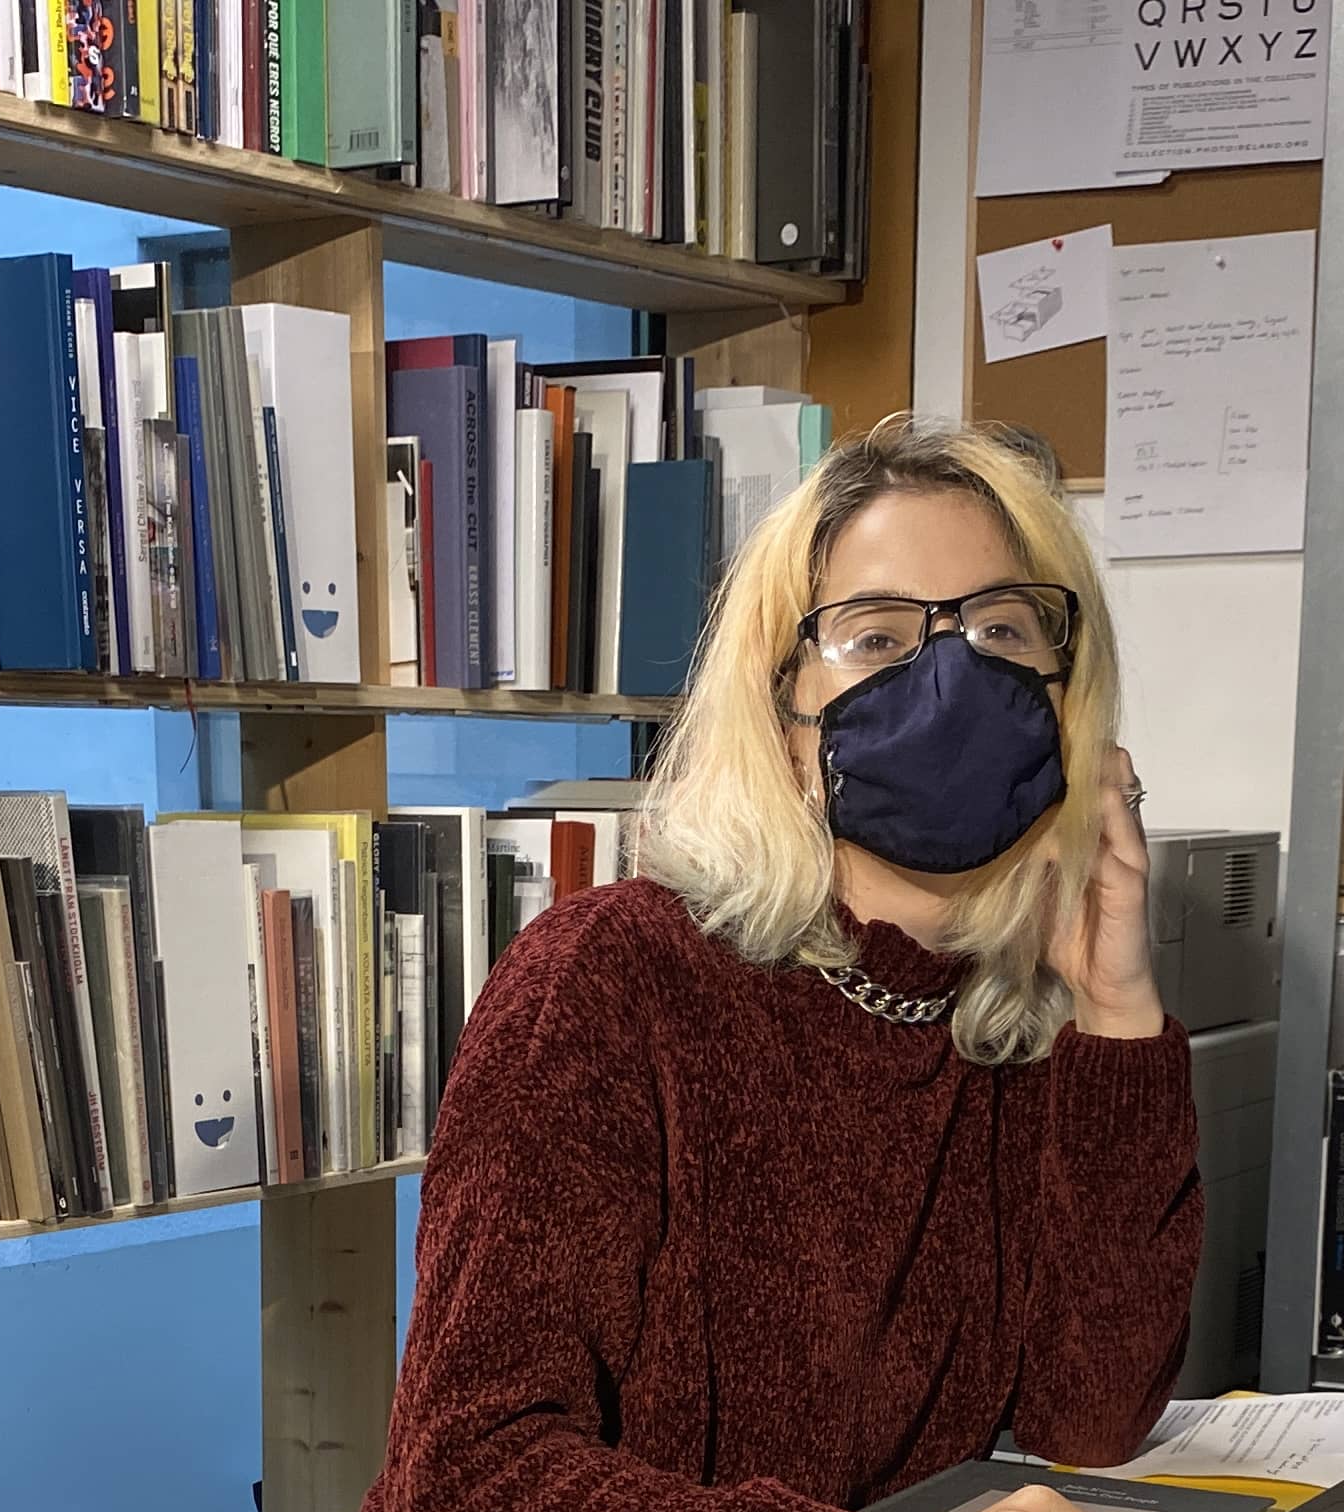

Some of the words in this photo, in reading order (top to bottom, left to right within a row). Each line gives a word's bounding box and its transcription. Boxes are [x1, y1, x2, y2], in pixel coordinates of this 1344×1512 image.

[267, 1, 280, 28] POR
[268, 62, 281, 96] ERES
[268, 99, 281, 153] NEGRO?
[585, 89, 604, 163] CLUB
[68, 375, 81, 453] VICE
[466, 390, 477, 468] ACROSS
[466, 477, 477, 505] the
[74, 478, 88, 575] VERSA
[466, 513, 477, 552] CUT
[81, 589, 91, 636] contrasto
[468, 611, 479, 666] CLEMENT
[68, 911, 83, 986] STOCKHOLM
[362, 952, 371, 1005] KOLKATA
[362, 1008, 372, 1067] CALCUTTA
